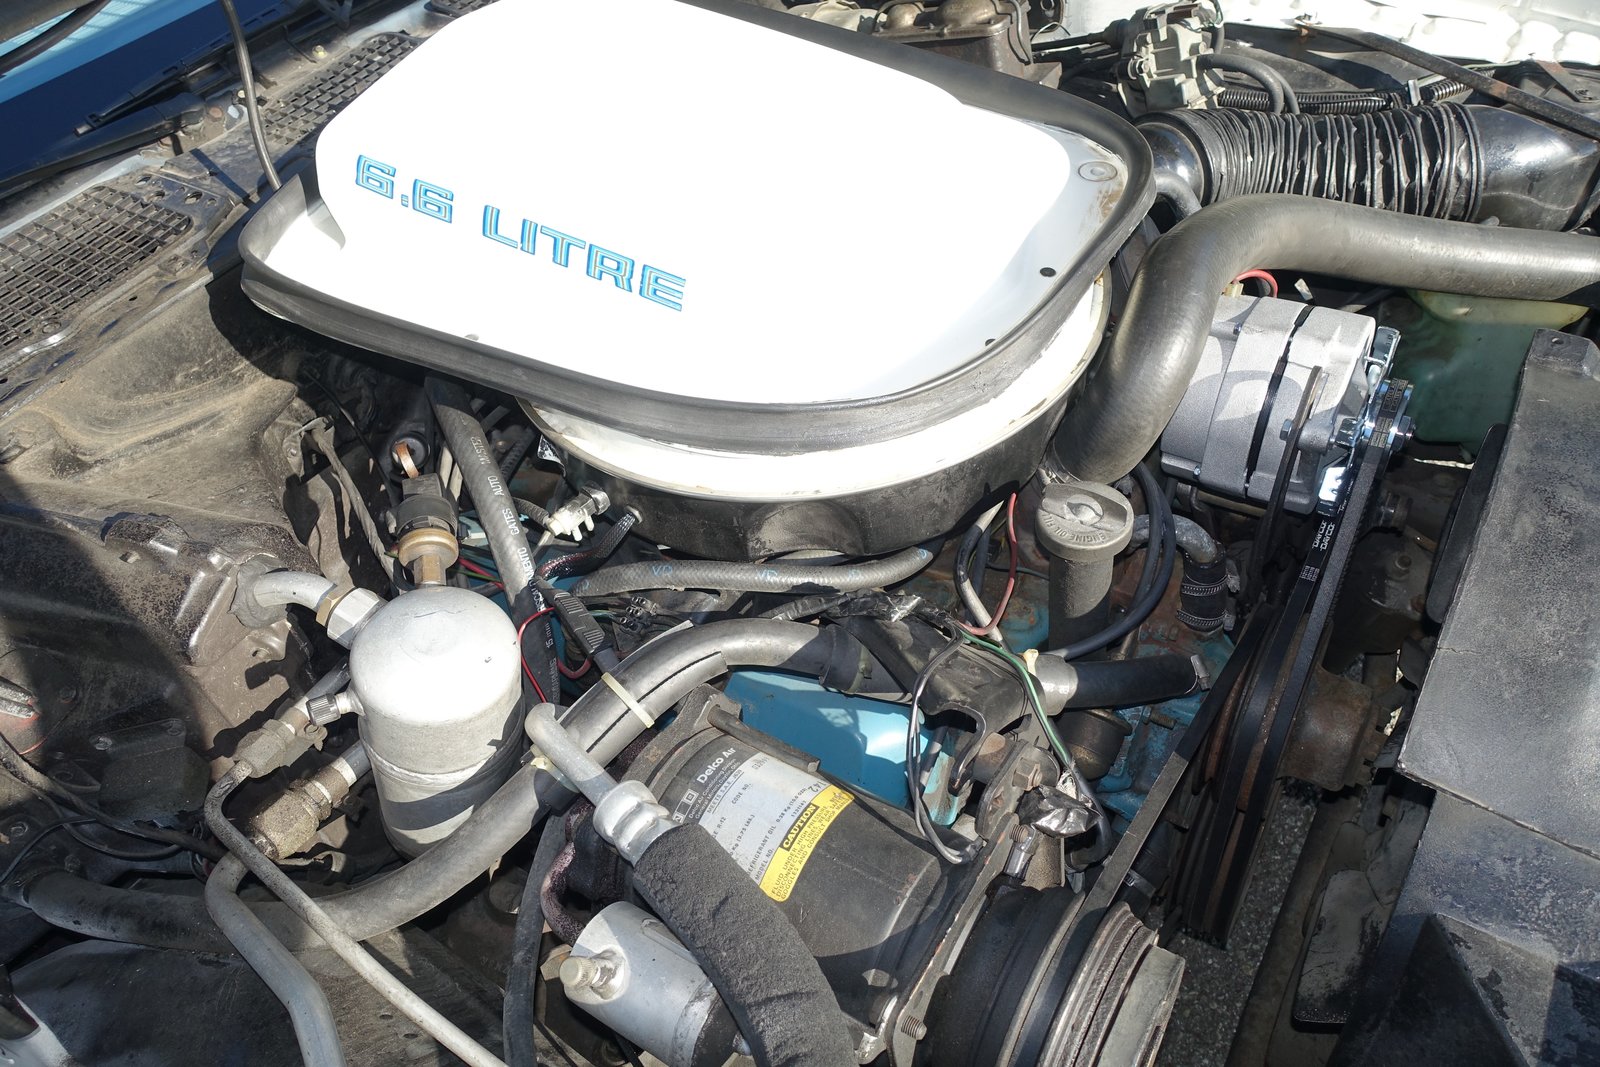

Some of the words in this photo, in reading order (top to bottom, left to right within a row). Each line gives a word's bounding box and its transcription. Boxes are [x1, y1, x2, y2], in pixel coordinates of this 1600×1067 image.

[355, 154, 454, 224] 6.6
[482, 204, 686, 312] LITRE
[471, 435, 490, 465] MASTER
[487, 475, 504, 496] AUTO
[502, 508, 520, 535] GATES
[1055, 527, 1068, 537] OIL
[1312, 520, 1327, 548] DAYCO
[1068, 531, 1106, 544] ENGINE
[1320, 522, 1335, 551] DAYCO
[697, 758, 724, 784] Delco
[722, 747, 736, 757] Air
[707, 794, 720, 813] MEETS
[732, 792, 742, 804] CODE
[742, 781, 751, 791] NO.
[767, 824, 776, 834] OIL
[783, 804, 816, 848] CAUTION
[754, 858, 768, 880] MODEL
[765, 846, 774, 857] NO.
[771, 872, 784, 894] FLUID
[782, 847, 796, 870] UNDER
[796, 829, 807, 845] HIGH
[776, 843, 805, 896] DISCONNECTING
[780, 866, 798, 899] GOGGLES
[797, 850, 808, 864] AND
[806, 823, 825, 848] CONSULT
